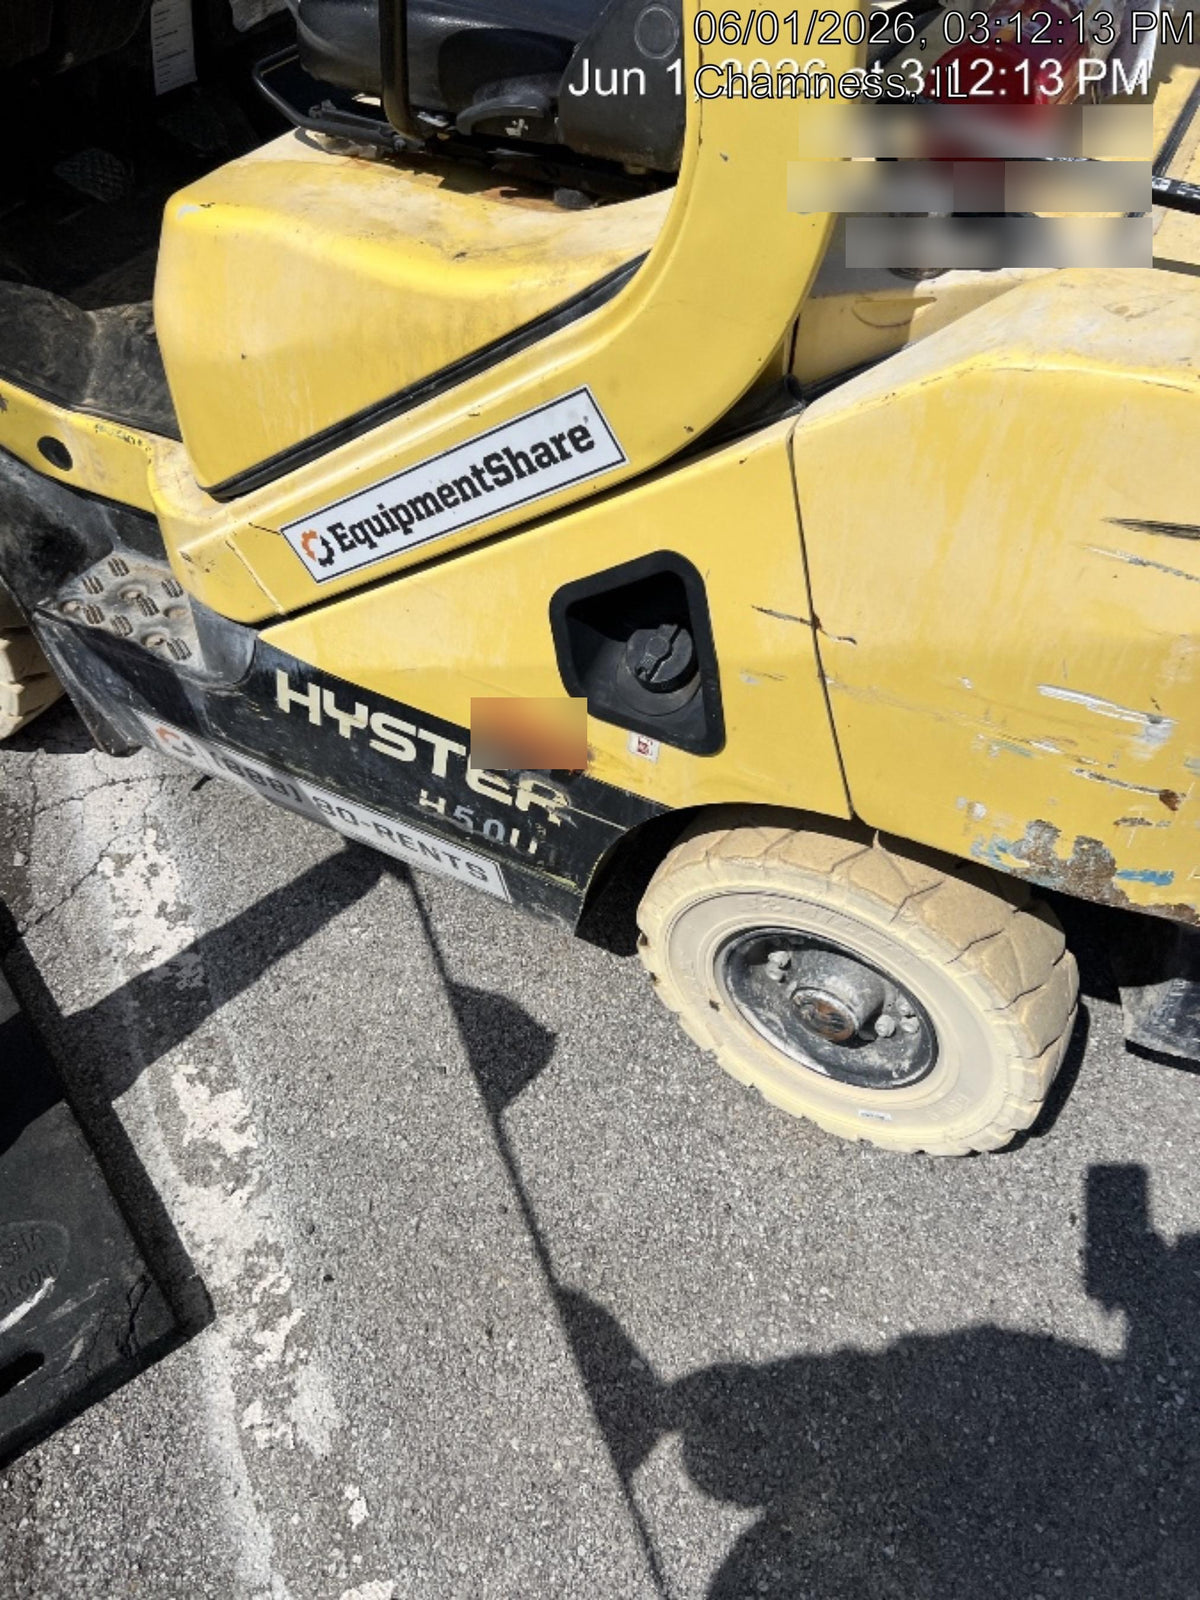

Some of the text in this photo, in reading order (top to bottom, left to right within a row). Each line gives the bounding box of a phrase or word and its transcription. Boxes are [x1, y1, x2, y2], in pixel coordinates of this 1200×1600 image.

[327, 424, 596, 550] EquipmentShare
[209, 751, 302, 802] (888)
[276, 668, 572, 827] HYSTER
